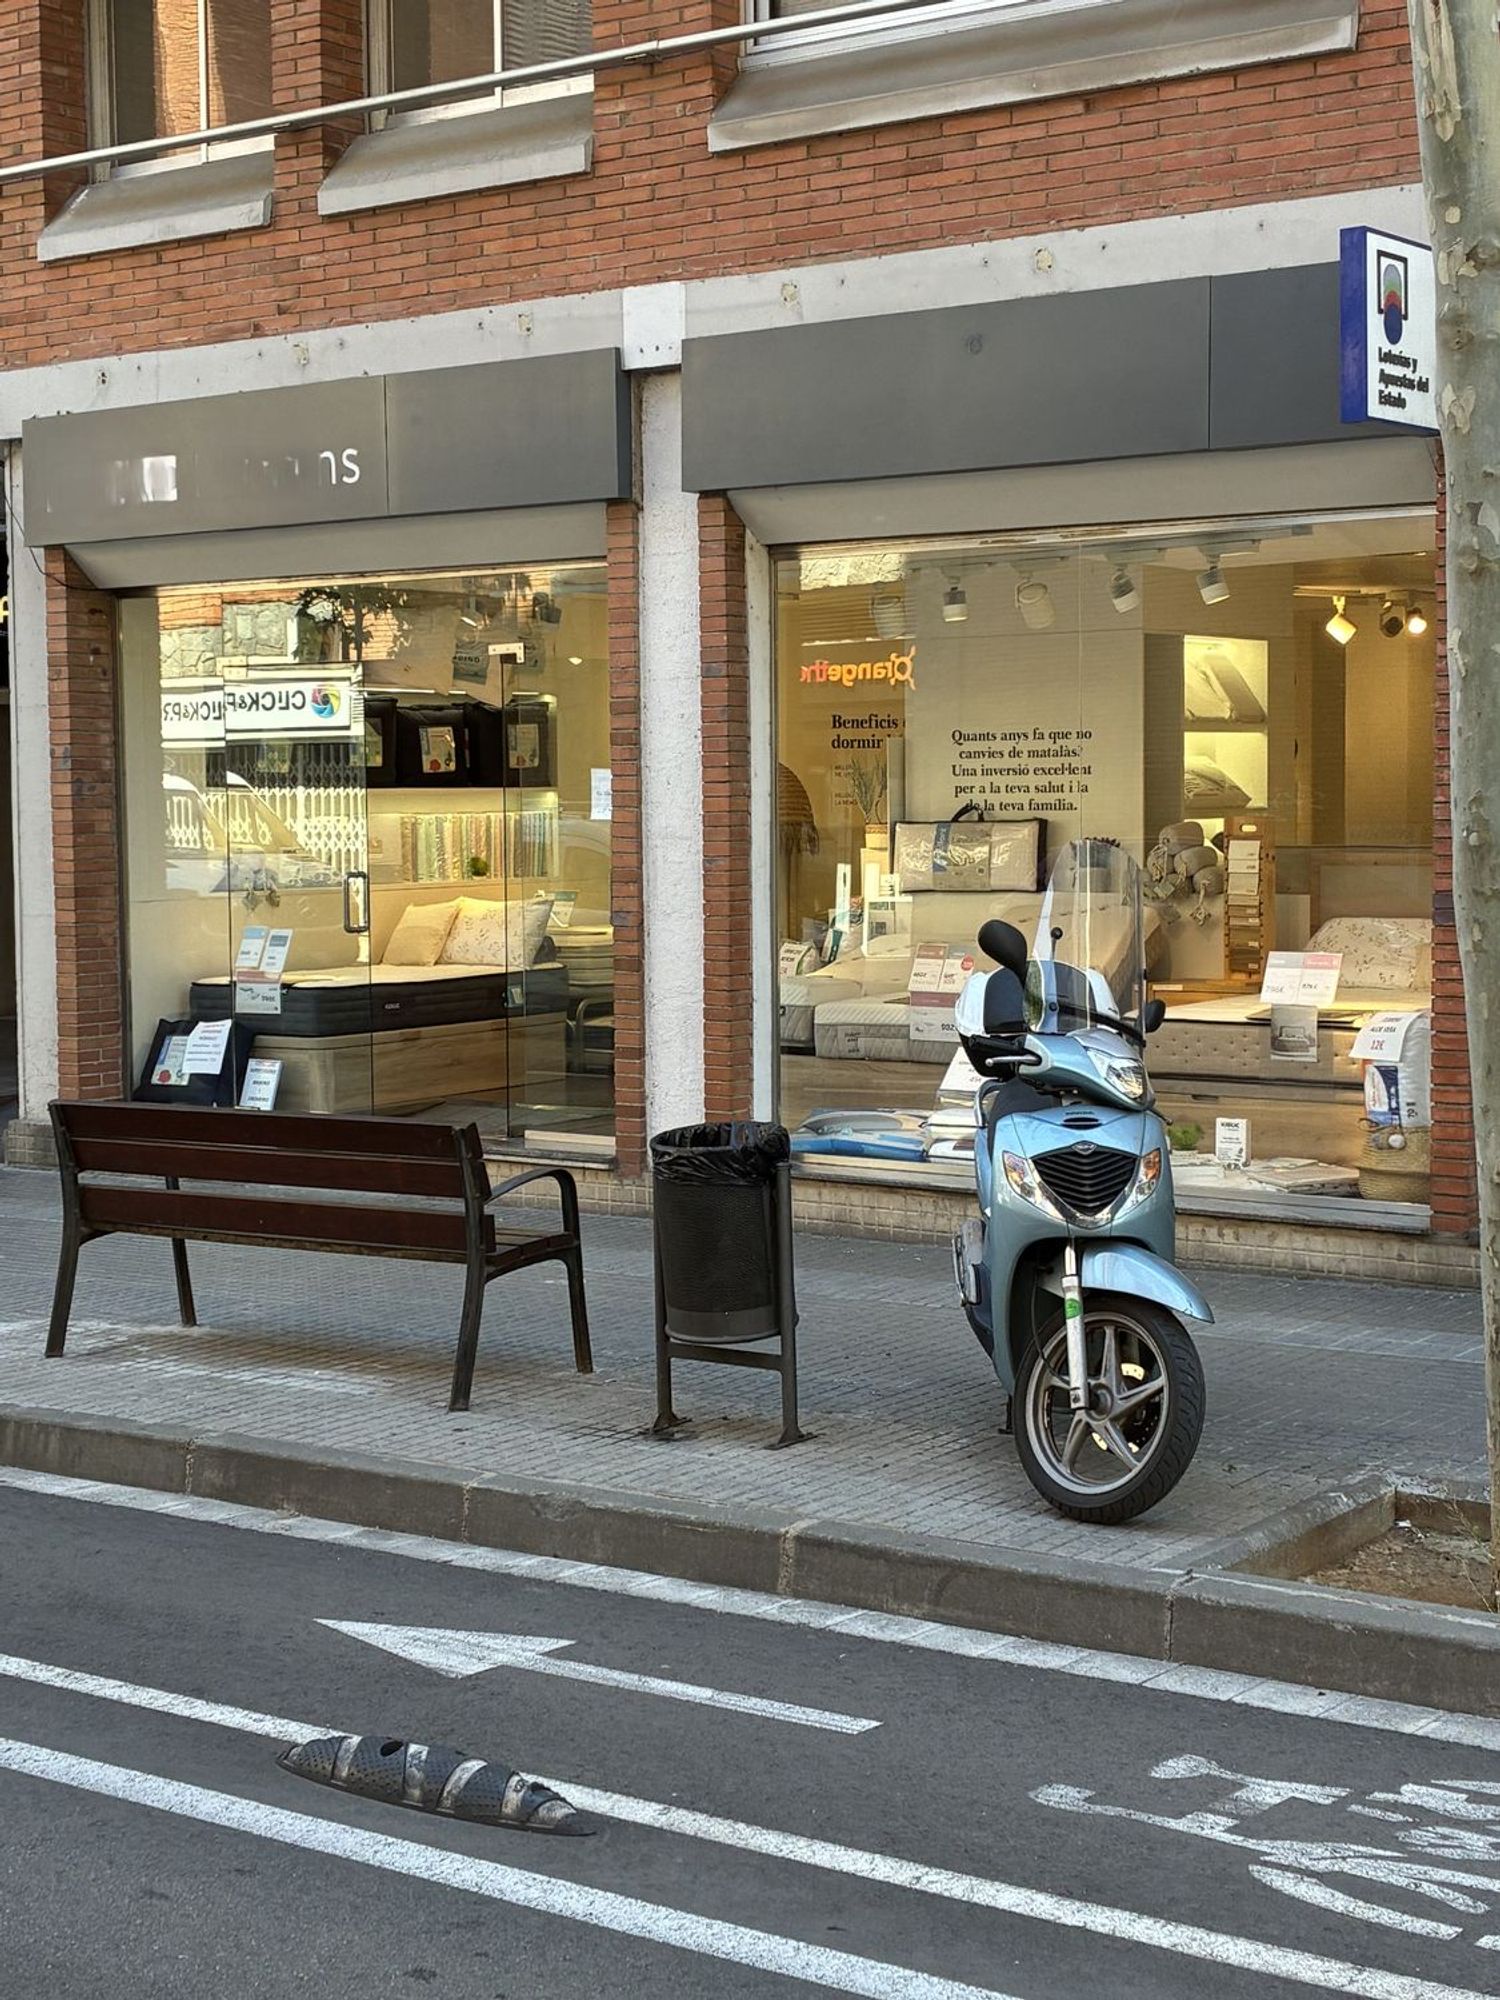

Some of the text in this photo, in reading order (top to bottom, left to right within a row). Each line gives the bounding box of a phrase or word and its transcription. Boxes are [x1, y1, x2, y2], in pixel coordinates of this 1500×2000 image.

[1378, 346, 1418, 374] Loterías y
[1378, 368, 1429, 393] Apuestas del
[1378, 389, 1407, 410] Estado
[831, 714, 898, 729] Beneficis
[831, 734, 884, 749] dormir
[951, 727, 1092, 745] Quants anys fa que no
[959, 746, 1004, 759] canvies
[1008, 746, 1023, 759] de
[951, 764, 977, 776] Una
[981, 763, 1029, 776] inversió
[954, 784, 975, 798] per
[978, 784, 986, 794] a
[990, 781, 1000, 794] la
[1005, 783, 1030, 793] teva
[1034, 781, 1064, 793] salut
[1069, 780, 1073, 793] i
[999, 802, 1024, 811] teva
[1028, 798, 1078, 811] família.
